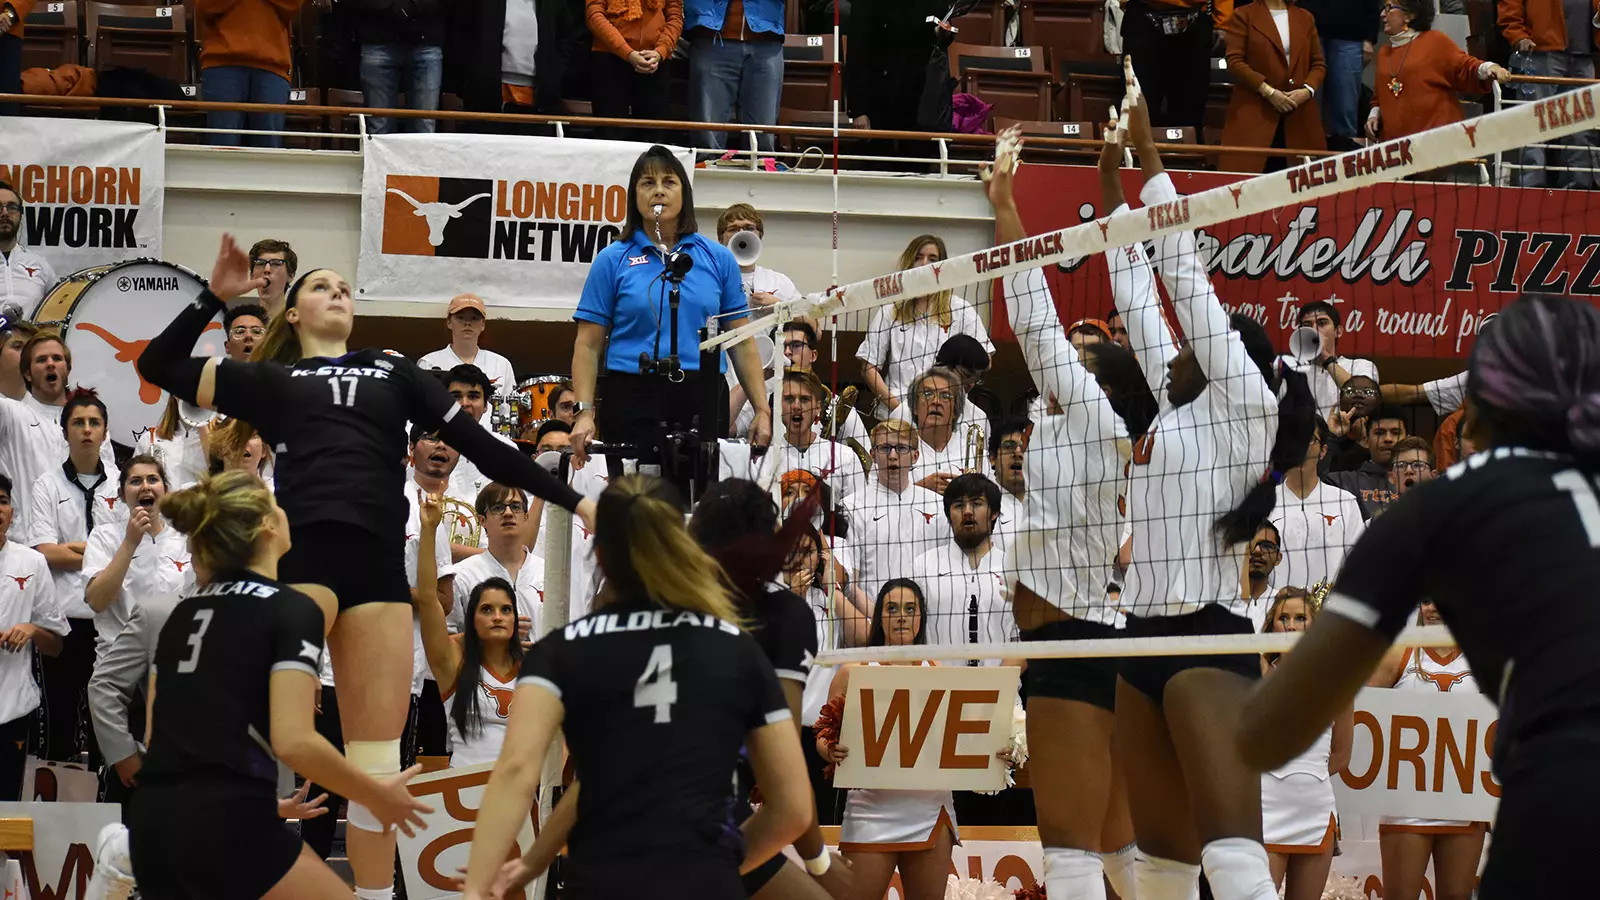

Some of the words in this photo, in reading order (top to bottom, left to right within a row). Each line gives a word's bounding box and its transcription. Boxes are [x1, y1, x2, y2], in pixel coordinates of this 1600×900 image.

[52, 3, 60, 12] 5
[160, 8, 168, 17] 6
[809, 37, 821, 47] 12
[1018, 48, 1028, 57] 14
[185, 87, 191, 96] 6
[1534, 89, 1596, 131] TEXAS
[1066, 125, 1077, 134] 14
[1287, 160, 1337, 194] TACO
[1344, 139, 1414, 179] SHACK
[496, 180, 627, 223] LONGHO
[1148, 198, 1190, 231] TEXAS
[25, 206, 139, 248] WORK
[493, 220, 622, 264] NETWO
[973, 247, 1010, 273] TACO
[1015, 232, 1065, 262] SHACK
[132, 276, 179, 291] YAMAHA
[873, 273, 904, 299] TEXAS
[1345, 310, 1365, 333] a
[1376, 298, 1452, 337] round
[1455, 308, 1484, 353] pi
[291, 366, 390, 379] K-STATE
[328, 376, 359, 407] 17
[1551, 468, 1600, 548] 1
[183, 580, 280, 599] ILDCATS
[177, 608, 215, 674] 3
[633, 644, 678, 724] 4
[859, 688, 1000, 769] WE
[1338, 710, 1502, 798] ORNS
